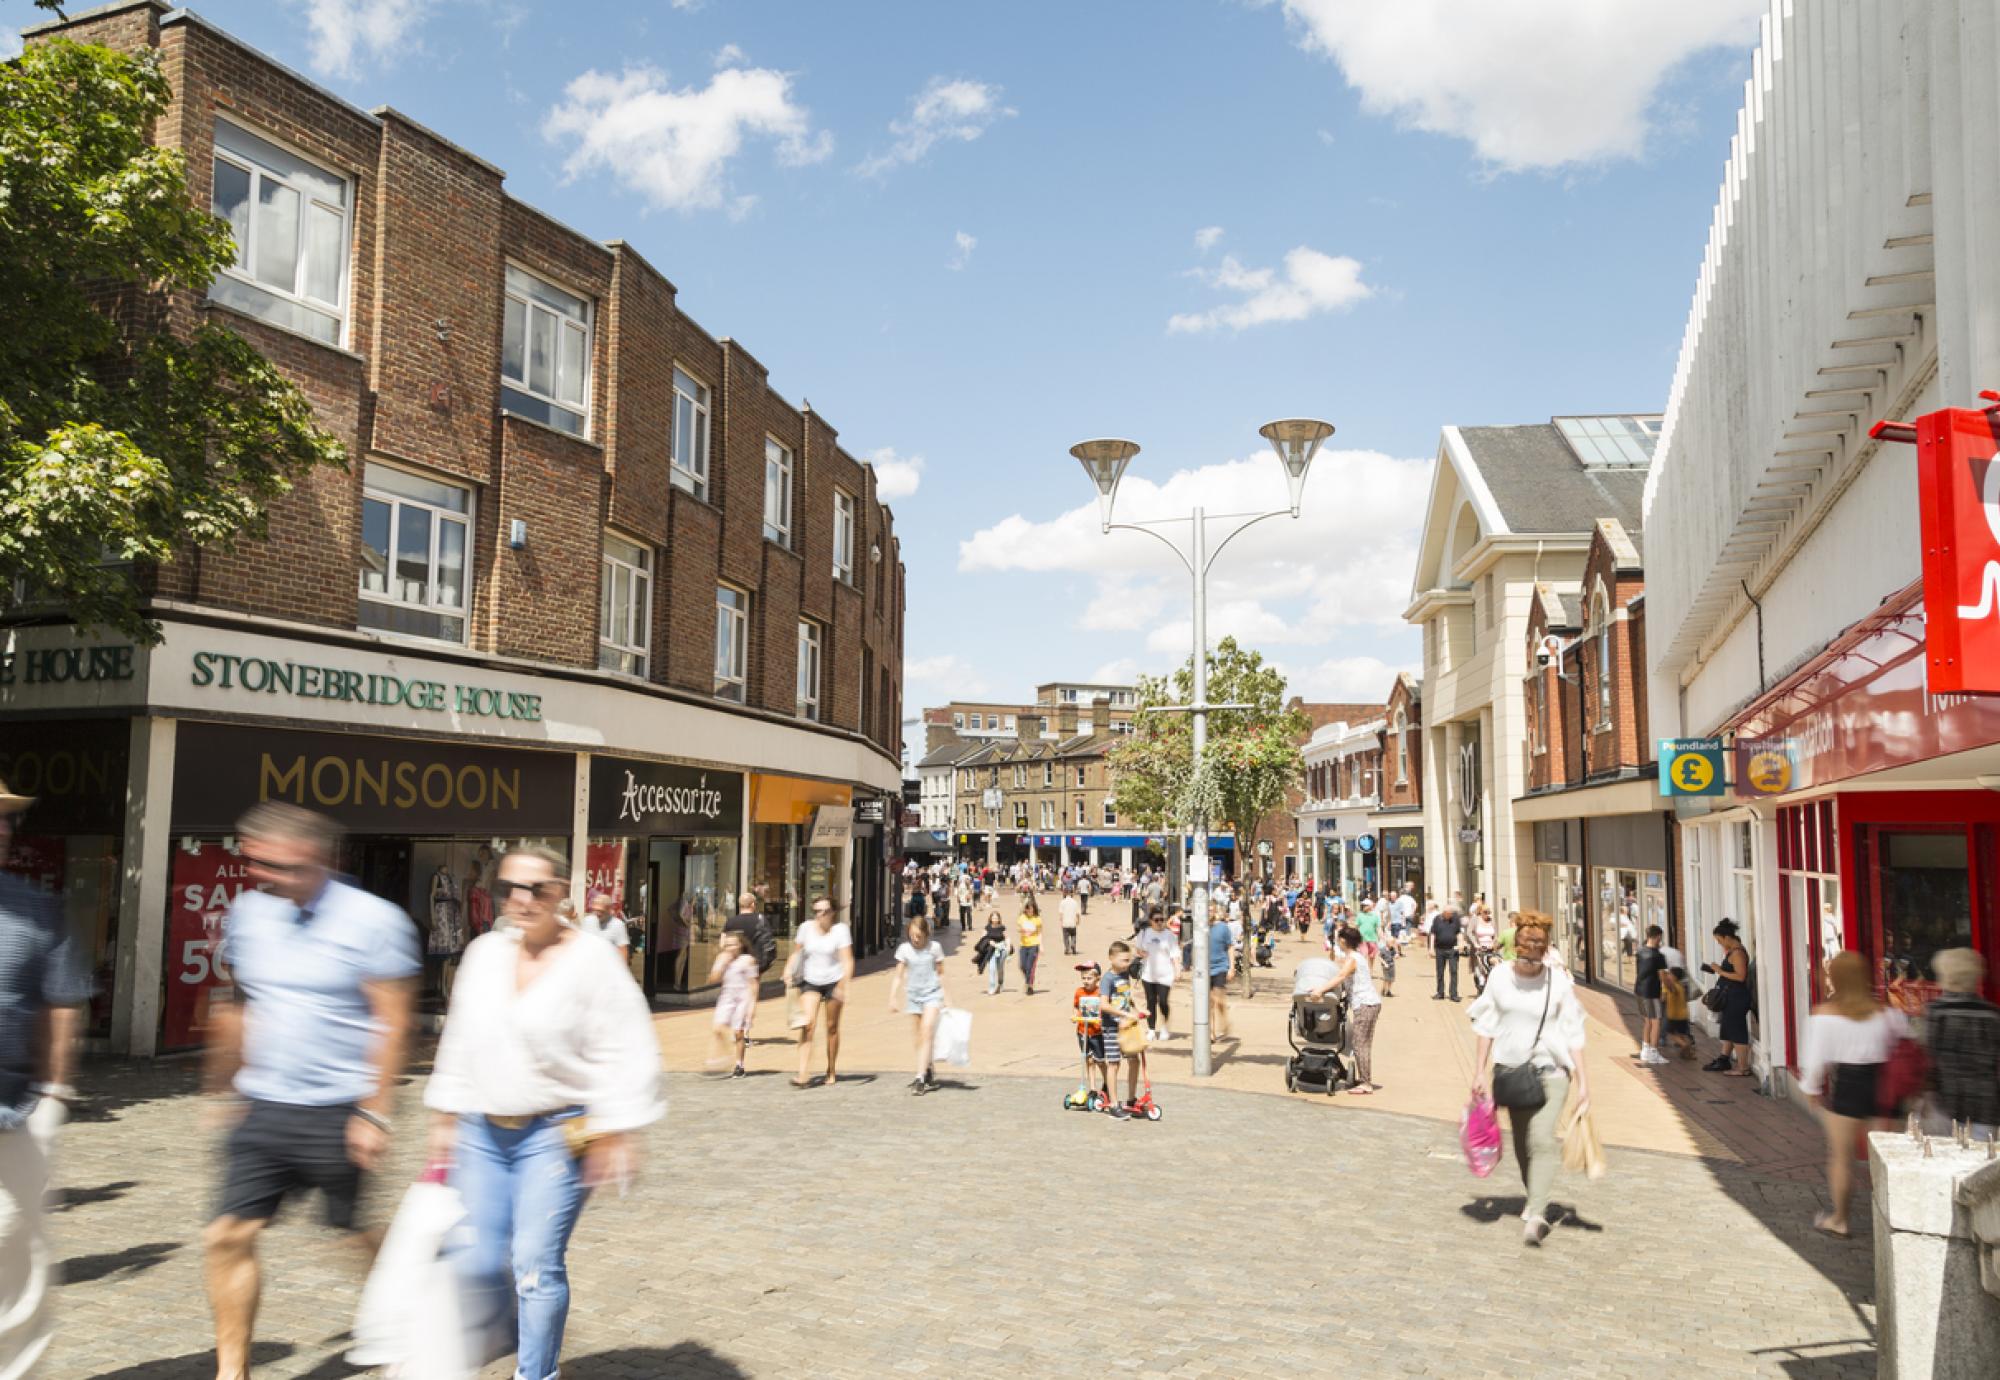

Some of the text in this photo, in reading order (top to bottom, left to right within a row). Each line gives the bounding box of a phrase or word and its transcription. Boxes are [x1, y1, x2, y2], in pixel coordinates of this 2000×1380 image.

[23, 645, 135, 684] HOUSE
[192, 651, 543, 722] STONEBRIDGE HOUSE
[1663, 741, 1719, 751] Poundland
[259, 752, 521, 810] MONSOON
[619, 769, 722, 823] Accessorize
[216, 865, 248, 878] ALL
[585, 869, 623, 889] SALE
